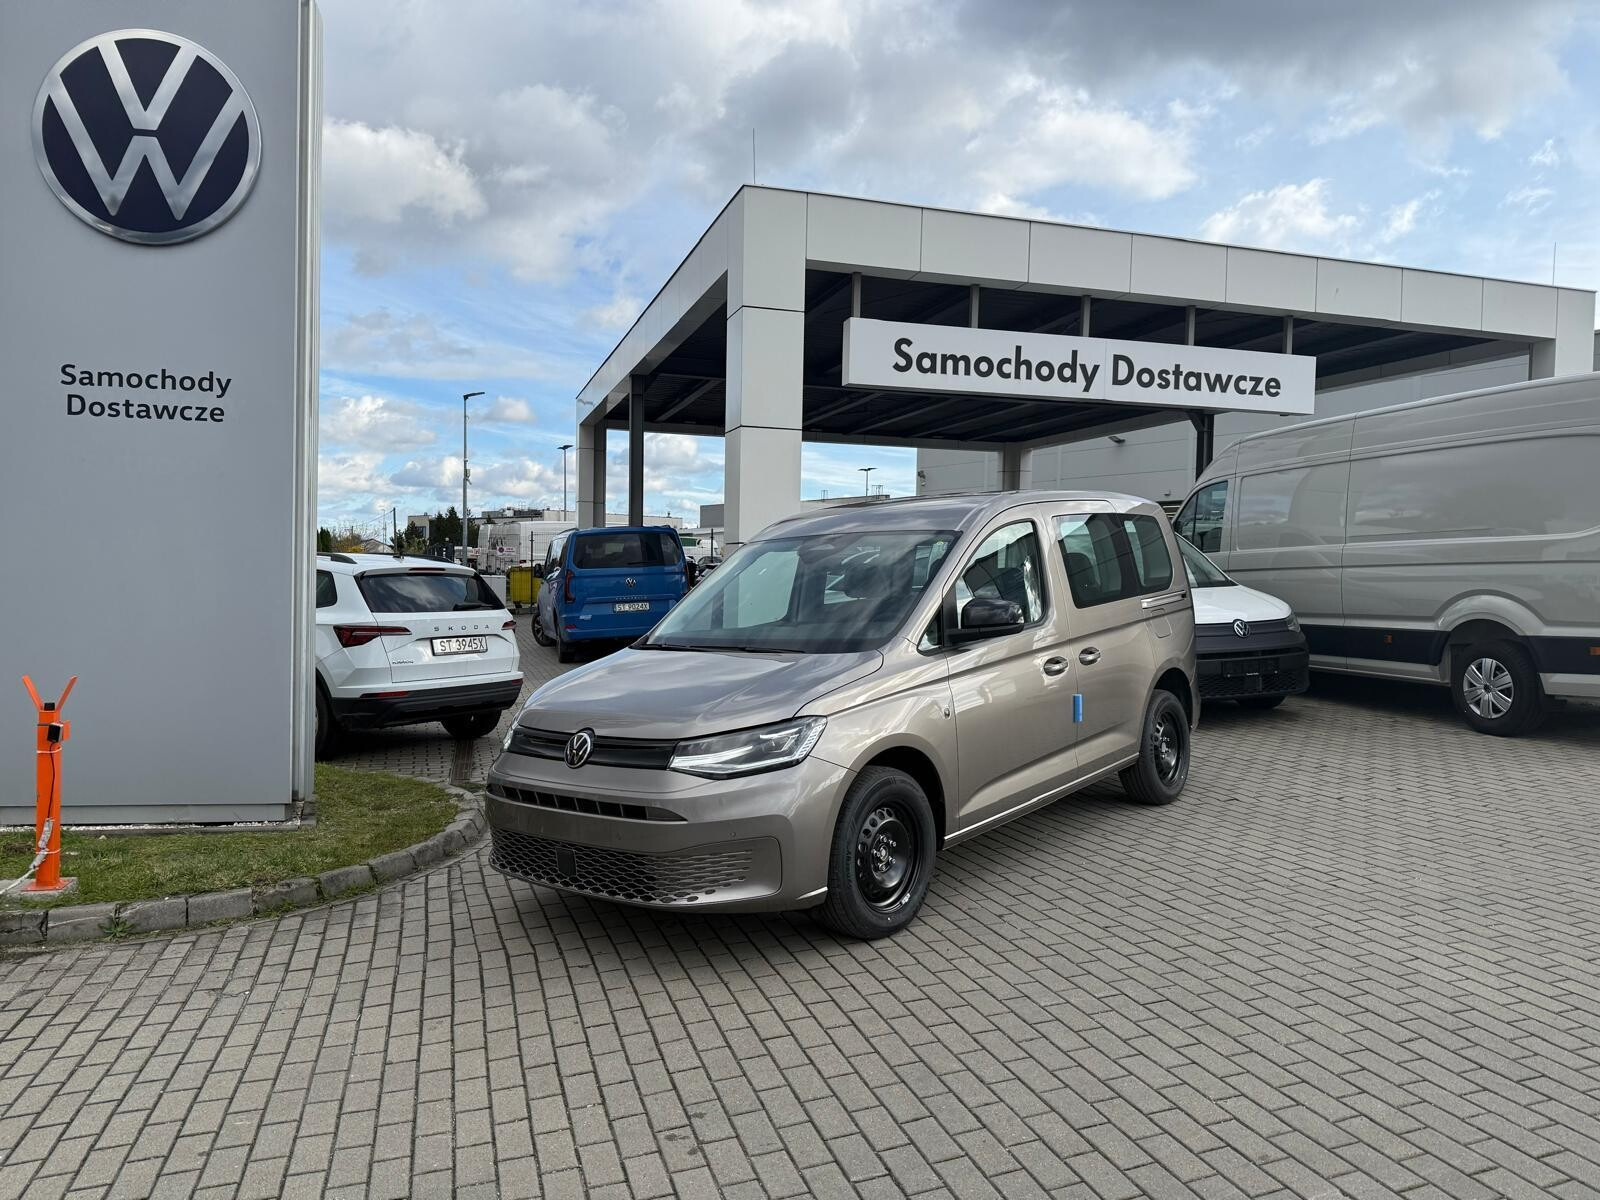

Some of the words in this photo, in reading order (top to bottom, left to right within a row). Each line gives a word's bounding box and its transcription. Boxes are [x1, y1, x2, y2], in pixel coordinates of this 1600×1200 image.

[32, 28, 262, 246] VW
[60, 363, 232, 398] Samochody
[892, 337, 1101, 393] Samochody
[1111, 353, 1282, 398] Dostawcze
[66, 393, 225, 423] Dostawcze
[440, 639, 452, 652] ST
[456, 637, 485, 651] 3945X
